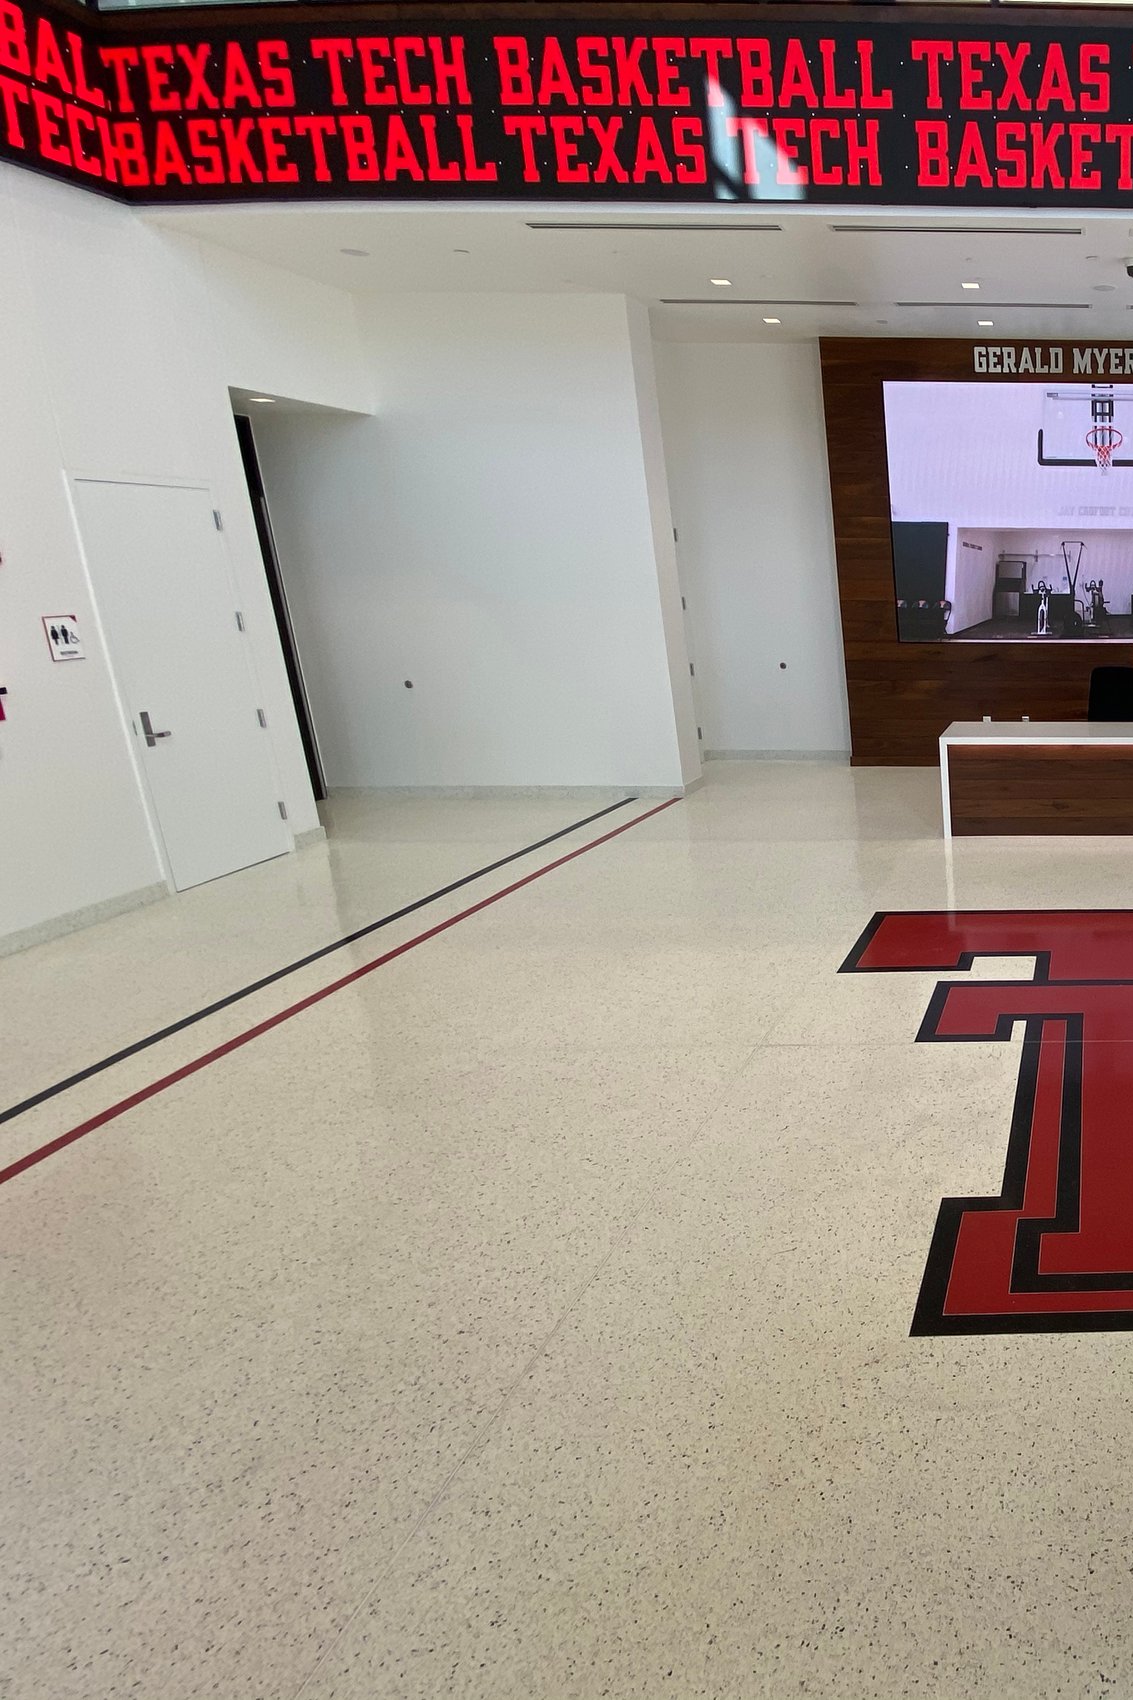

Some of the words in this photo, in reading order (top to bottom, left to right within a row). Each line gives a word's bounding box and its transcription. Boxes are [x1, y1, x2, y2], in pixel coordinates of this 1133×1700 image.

[99, 40, 295, 112] TEXAS
[311, 36, 471, 106] TECH
[493, 36, 893, 109] BASKETBALL
[911, 40, 1110, 112] TEXAS
[113, 114, 497, 186] BASKETBALL
[503, 115, 707, 183] TEXAS
[727, 117, 882, 186] TECH
[973, 346, 1064, 373] GERALD
